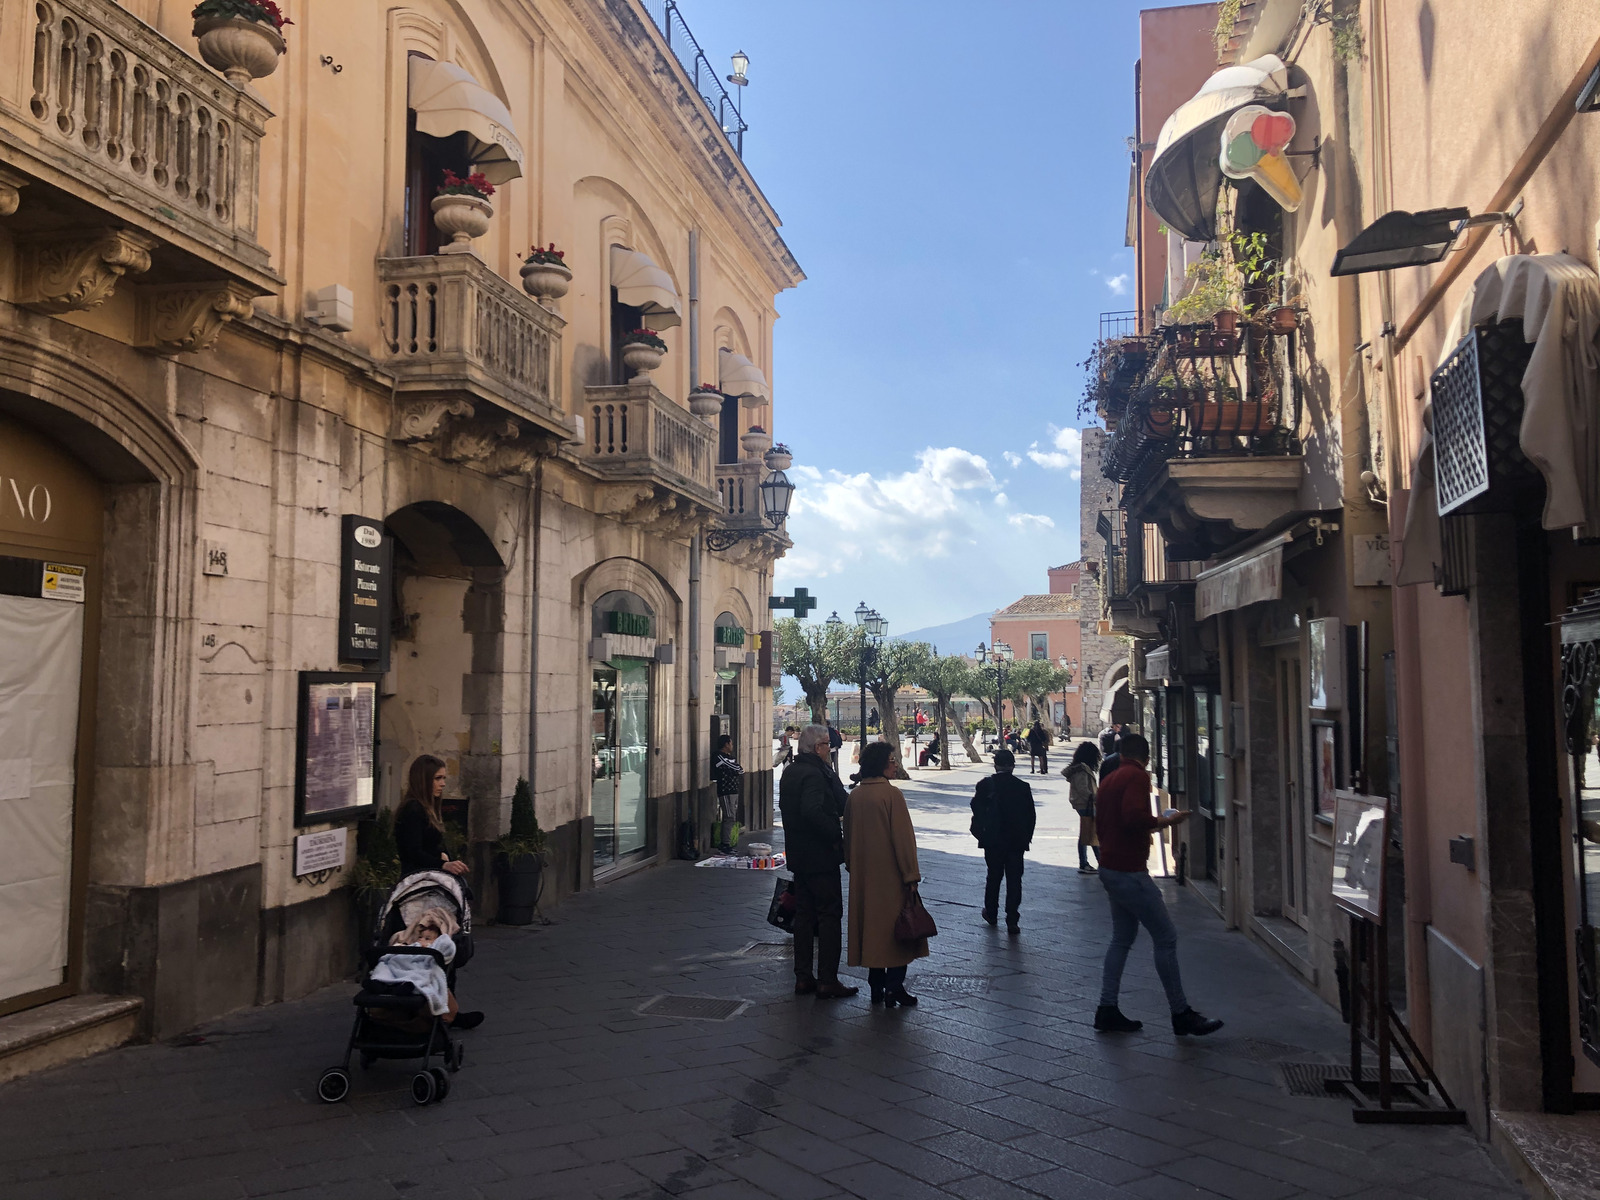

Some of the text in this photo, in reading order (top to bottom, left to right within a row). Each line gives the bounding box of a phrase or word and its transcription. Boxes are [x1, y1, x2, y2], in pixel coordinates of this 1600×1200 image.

[363, 527, 375, 536] Dal
[360, 536, 376, 546] 1988
[208, 549, 227, 566] 148
[222, 564, 229, 575] A
[354, 559, 381, 575] Ristorante
[356, 577, 378, 592] Pizzeria
[353, 593, 378, 607] Taormina
[617, 611, 650, 635] BRITISH
[201, 634, 216, 648] 148
[602, 633, 656, 658] HARMACY
